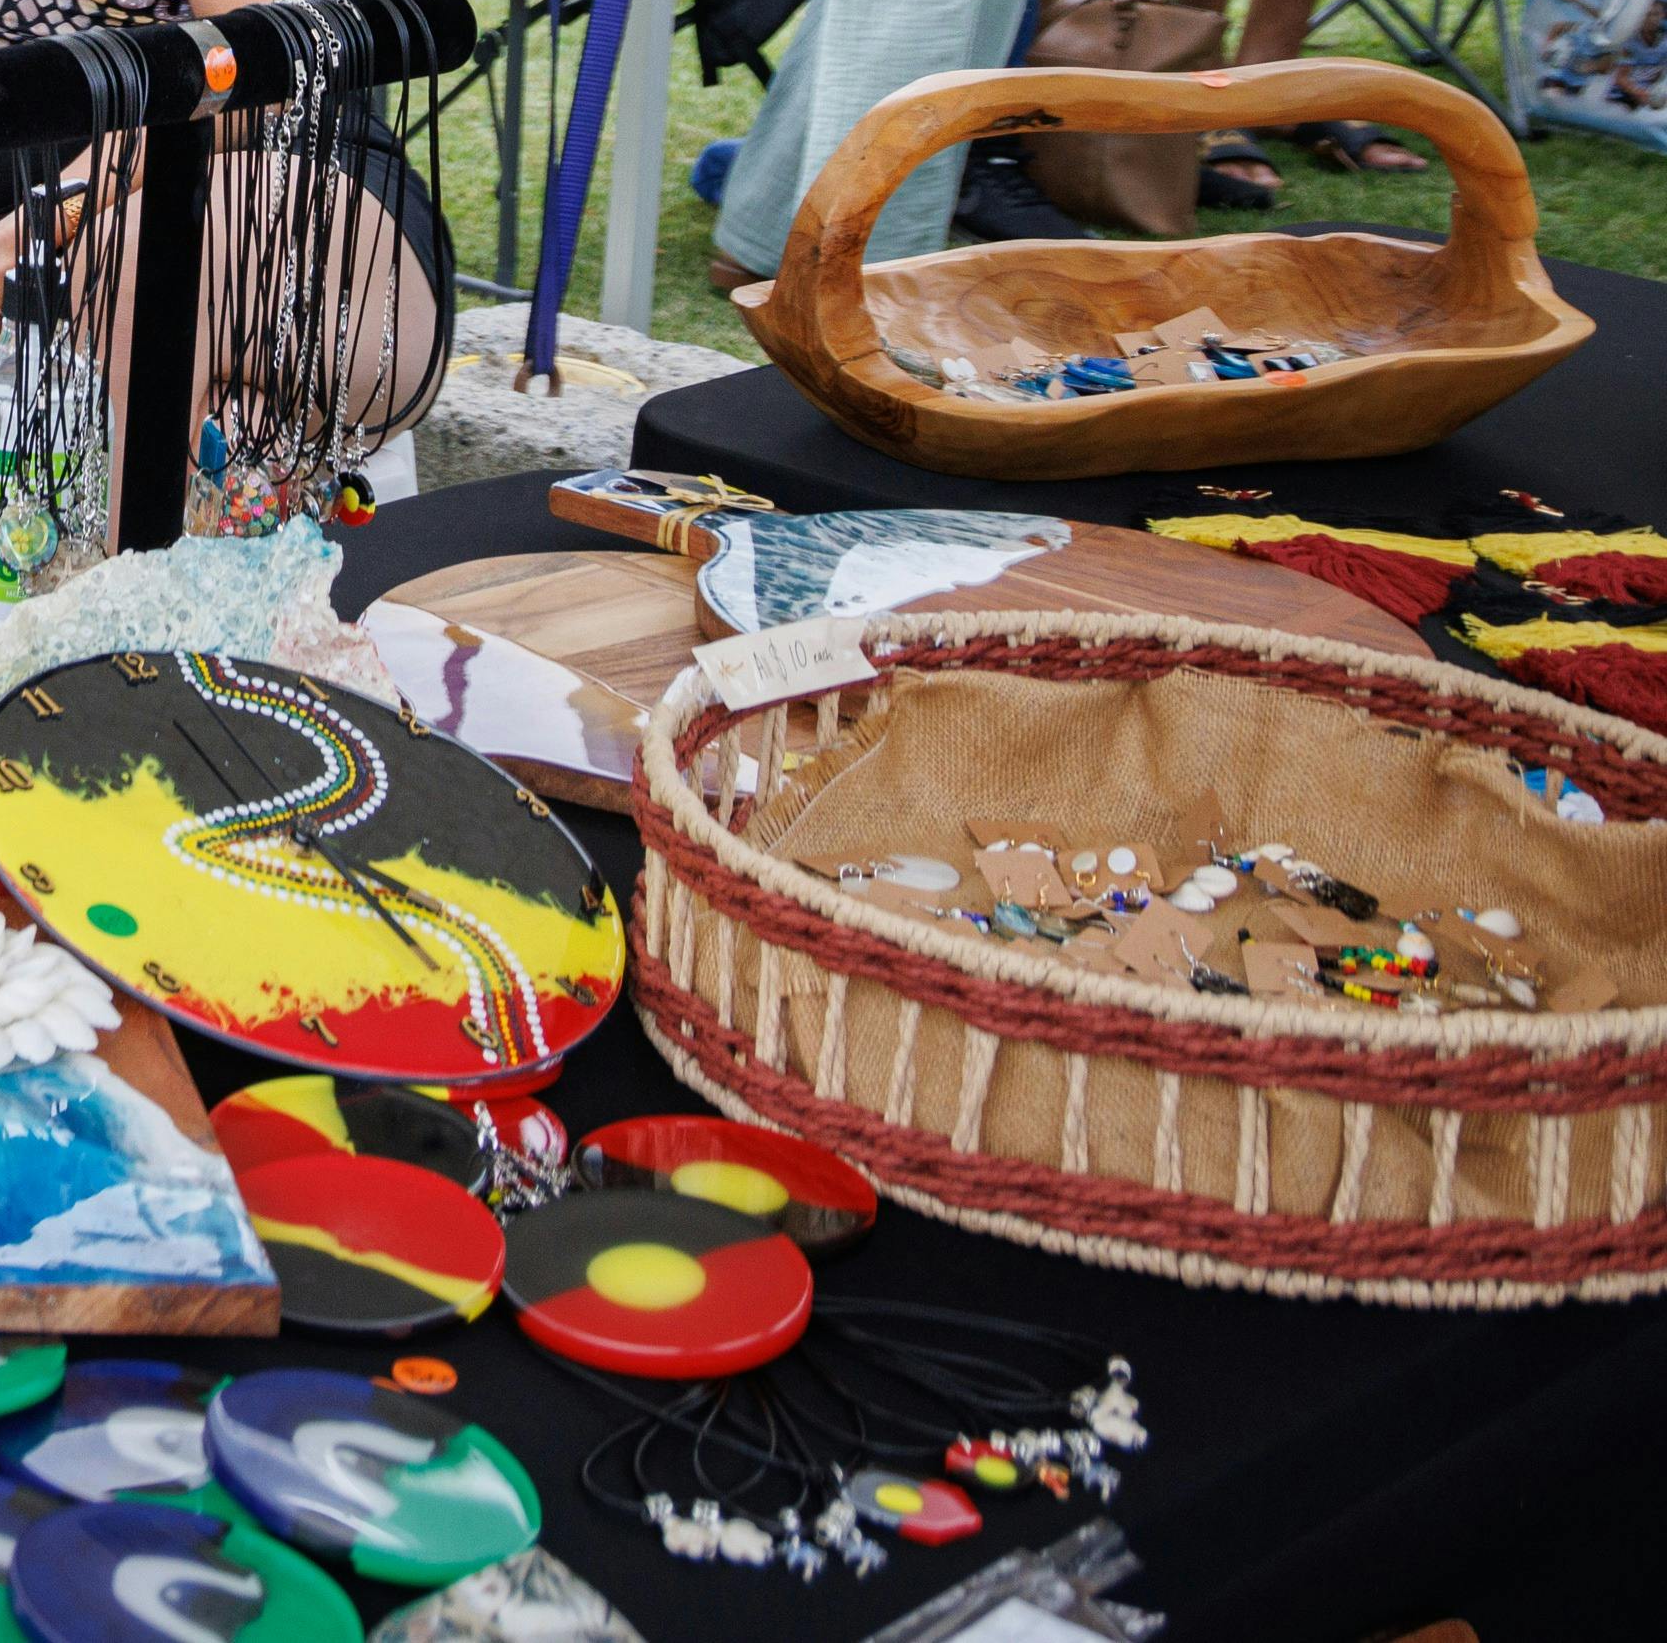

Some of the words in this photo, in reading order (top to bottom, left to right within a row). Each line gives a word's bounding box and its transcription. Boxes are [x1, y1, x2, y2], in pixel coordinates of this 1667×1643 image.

[113, 652, 159, 684] 12
[813, 647, 834, 663] each
[21, 686, 64, 720] 11
[299, 675, 330, 701] 1
[398, 707, 430, 738] 2
[515, 787, 550, 819] 3
[300, 1014, 338, 1047] 7
[460, 1015, 499, 1050] 6
